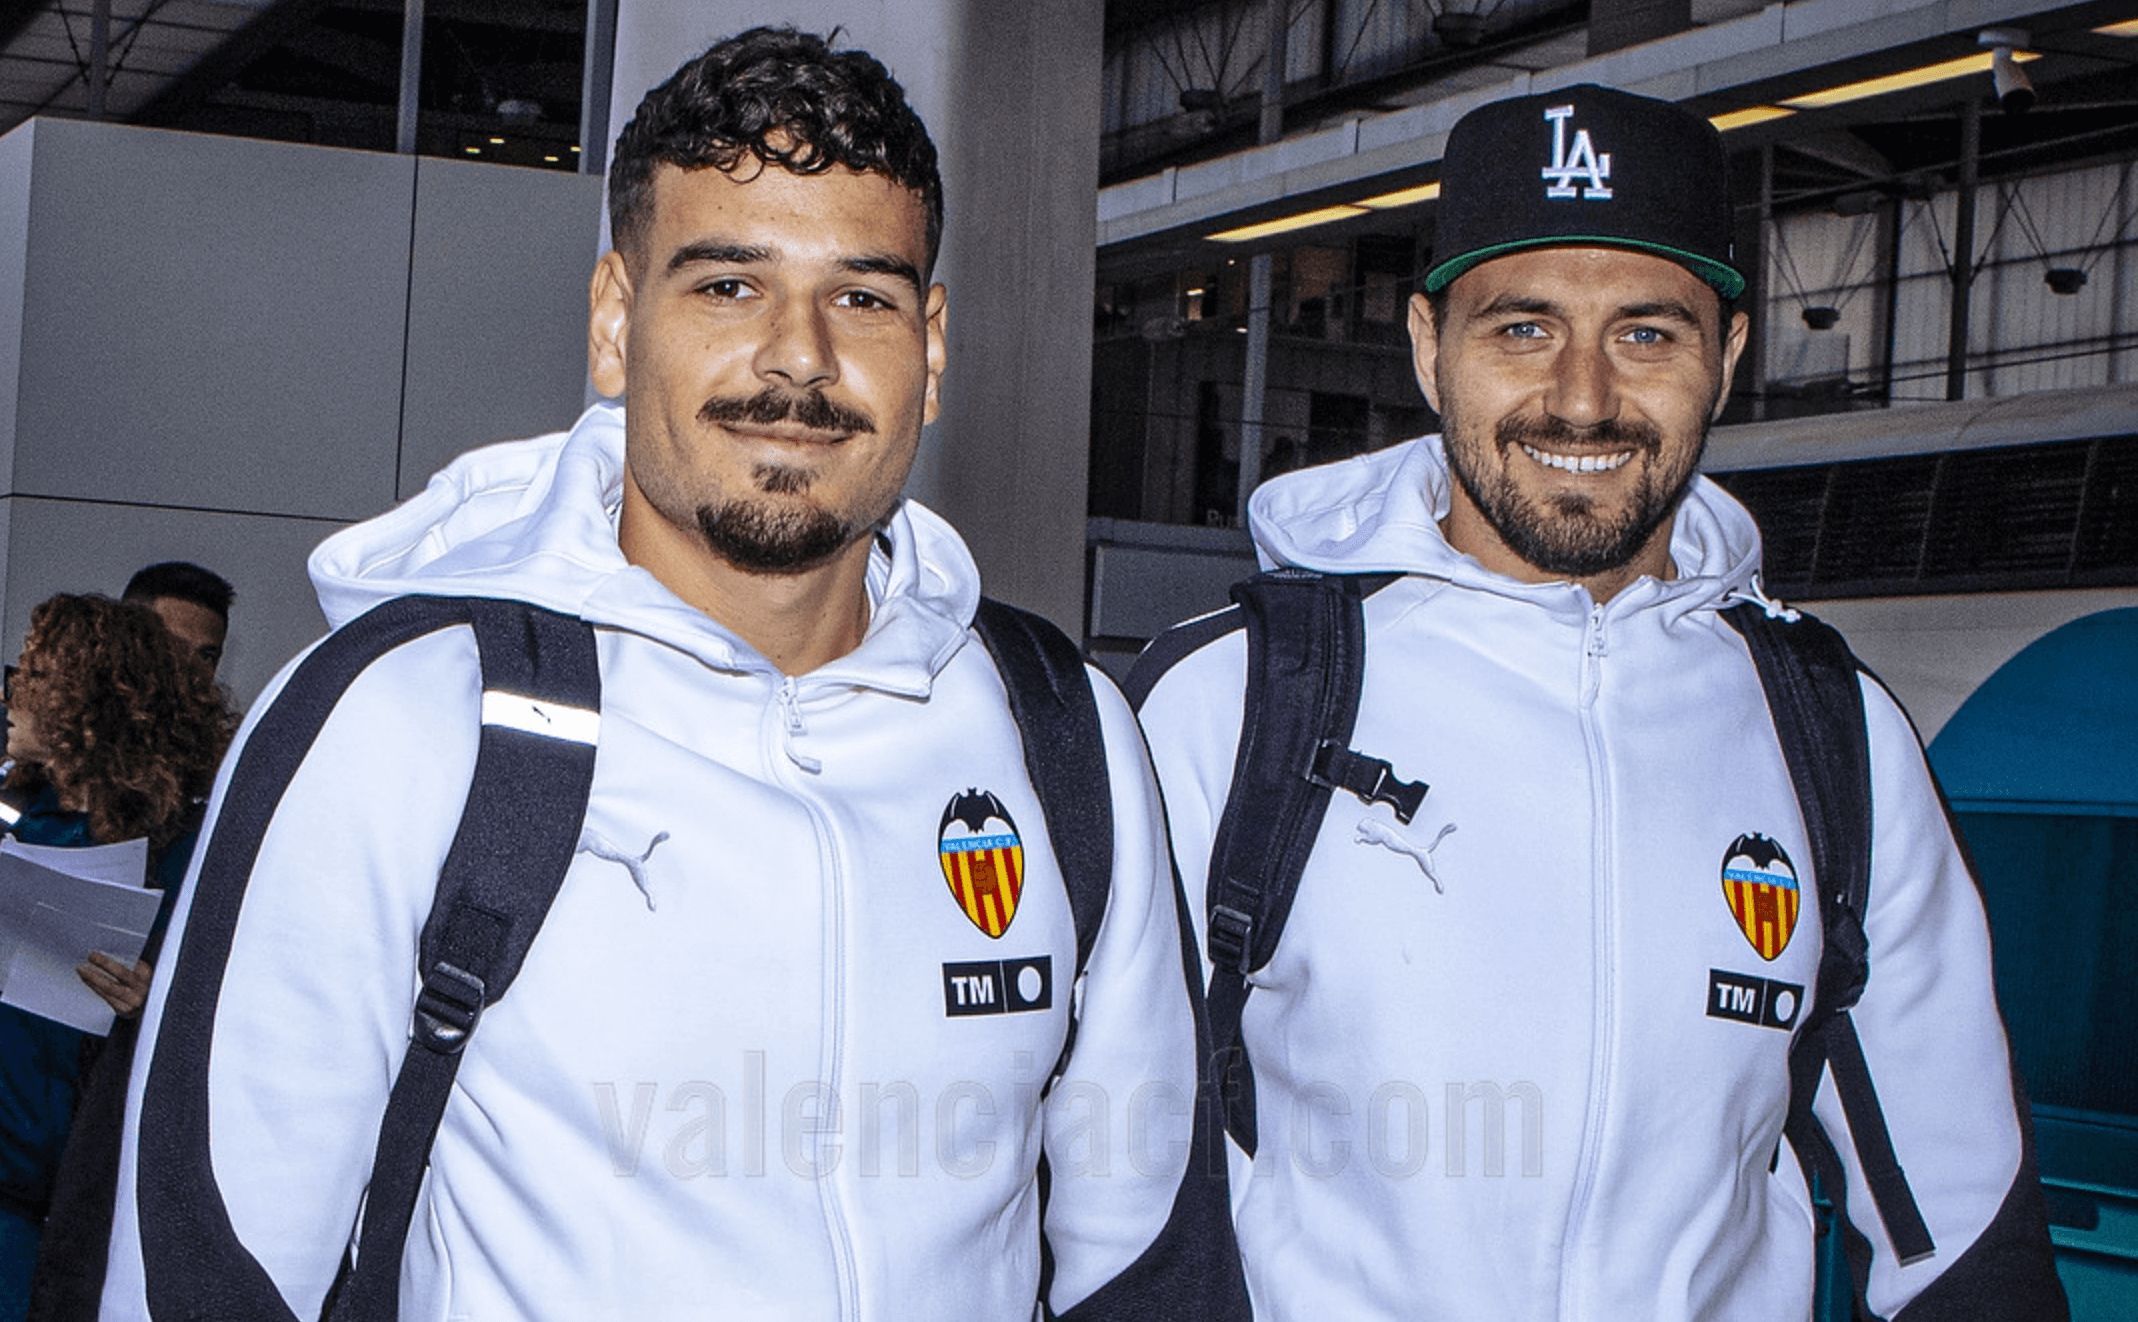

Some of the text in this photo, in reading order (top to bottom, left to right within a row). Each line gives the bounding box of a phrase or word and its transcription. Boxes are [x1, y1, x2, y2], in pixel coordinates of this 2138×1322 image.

[1541, 104, 1613, 199] LA
[951, 975, 995, 1006] TM
[1716, 983, 1756, 1014] TM
